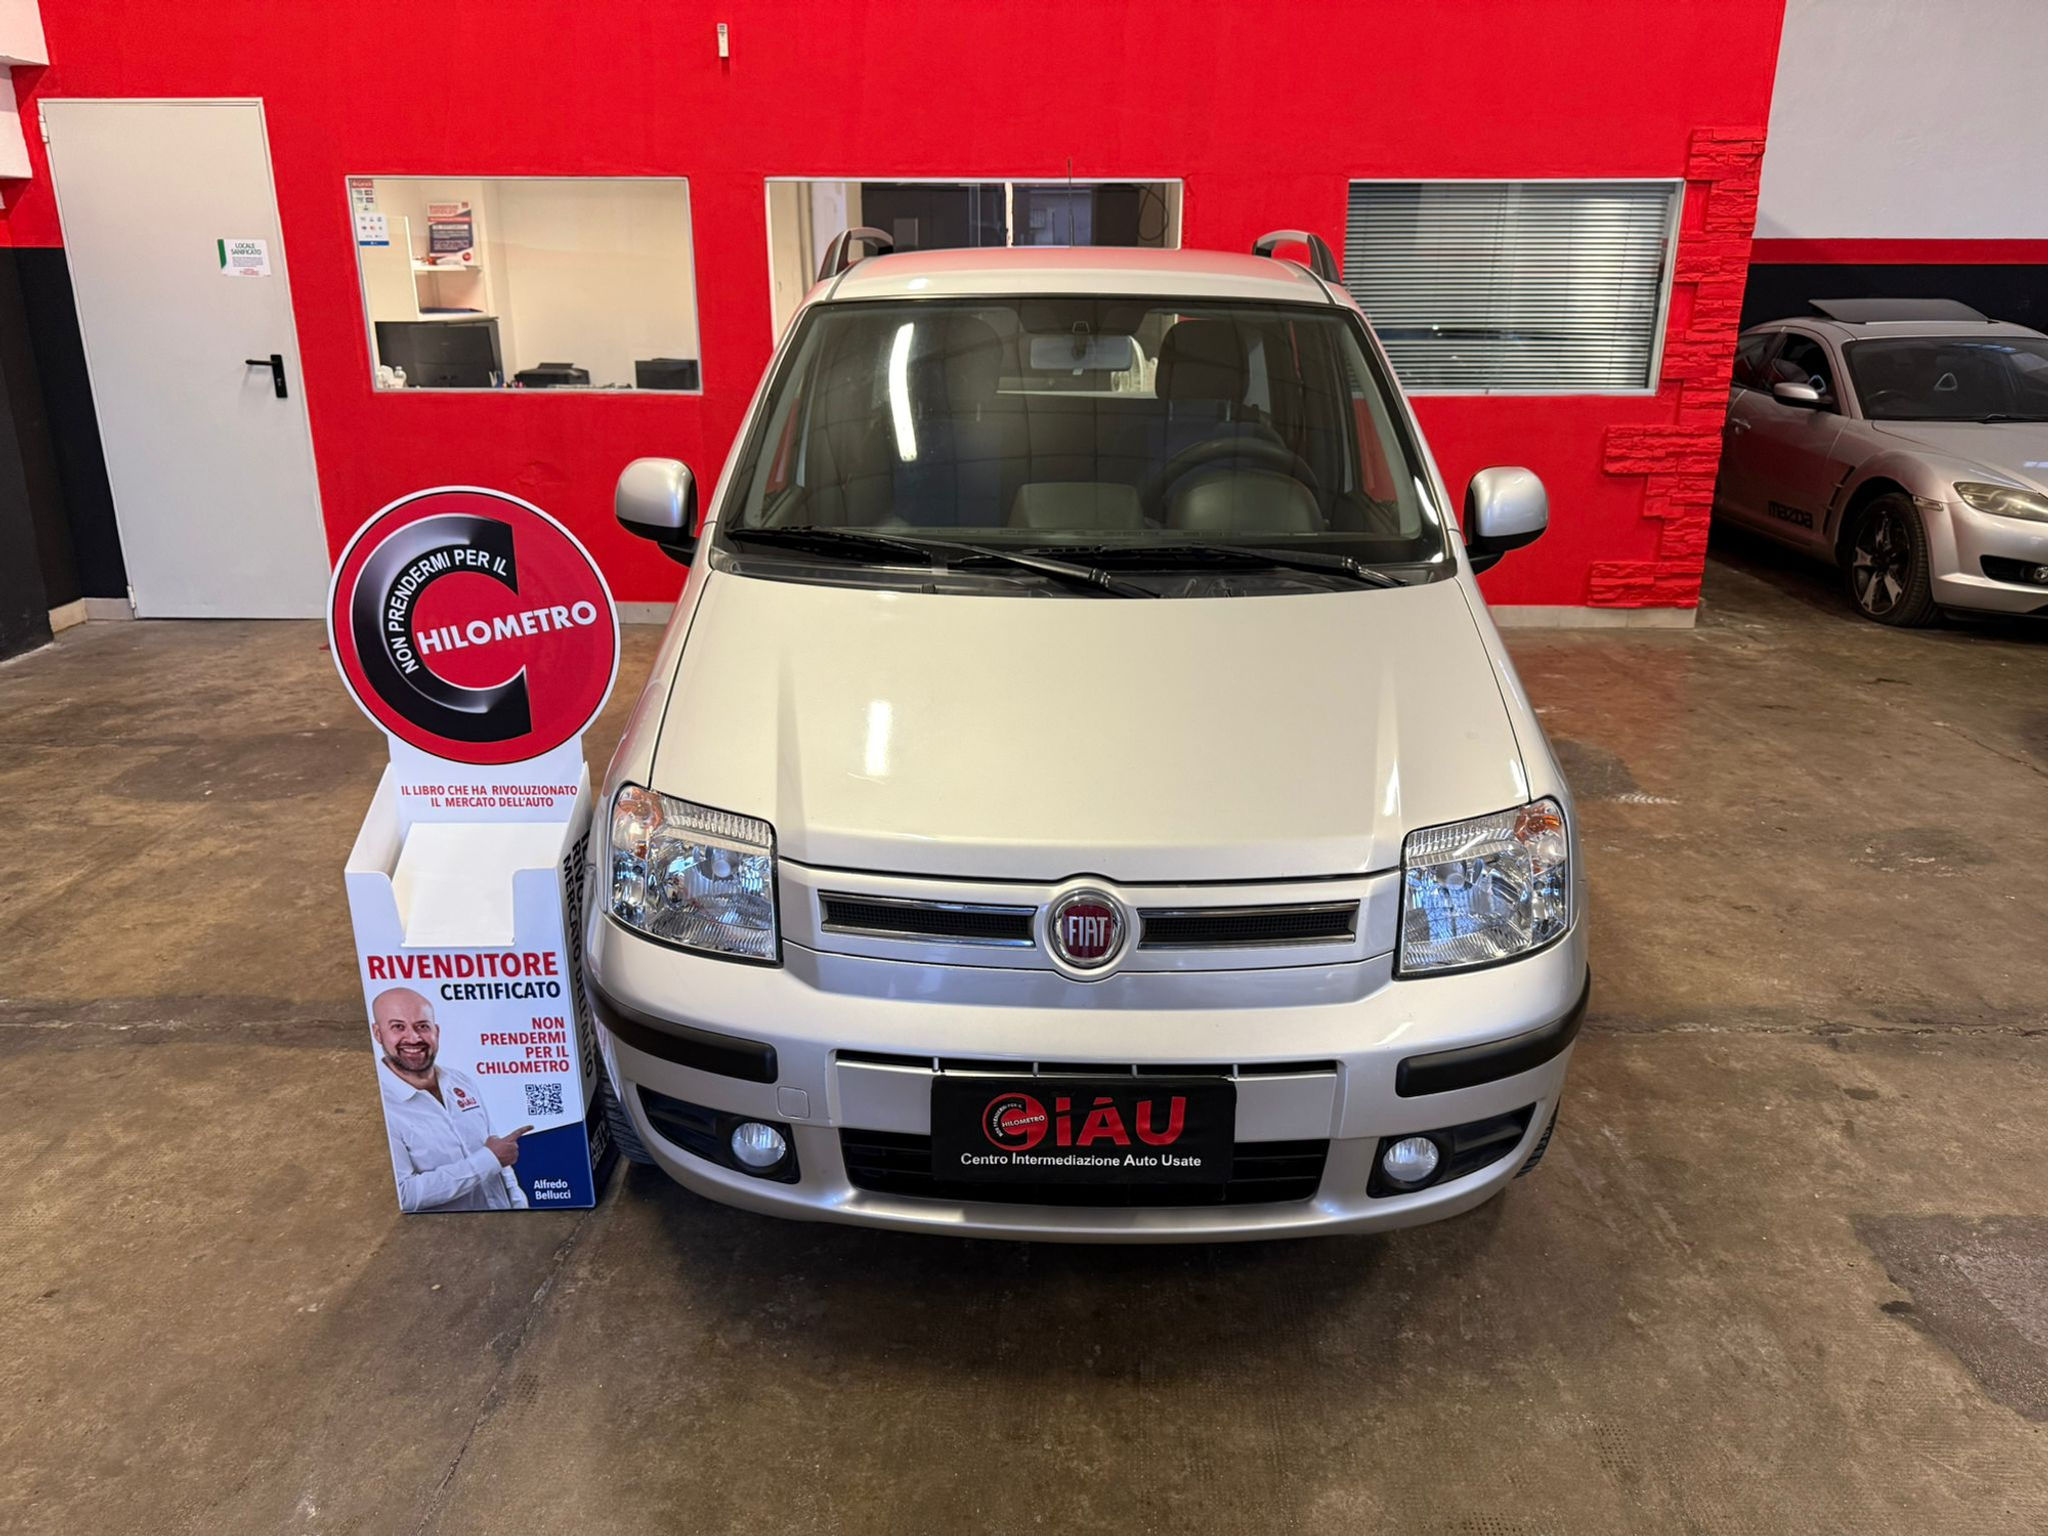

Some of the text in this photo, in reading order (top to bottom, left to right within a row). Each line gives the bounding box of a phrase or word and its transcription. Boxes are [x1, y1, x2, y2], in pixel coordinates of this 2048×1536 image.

[1768, 501, 1813, 529] mazda
[388, 549, 507, 674] NON PRENDERMI PER IL
[401, 785, 578, 796] IL LIBRO CHE HA RIVOLUZIONATO
[431, 796, 554, 808] IL MERCATO DELL'AUTO
[1069, 916, 1108, 947] FIAT
[367, 952, 559, 980] RIVENDITORE
[440, 981, 561, 1001] CERTIFICATO
[531, 1017, 565, 1030] NON
[480, 1031, 567, 1046] PRENDERMI
[525, 1045, 569, 1059] PER IL
[476, 1060, 570, 1075] CHILOMETRO
[960, 1152, 1202, 1168] Centro Intermediazione Auto Usate
[533, 1179, 568, 1189] Alfredo
[535, 1189, 572, 1200] Bellucci
